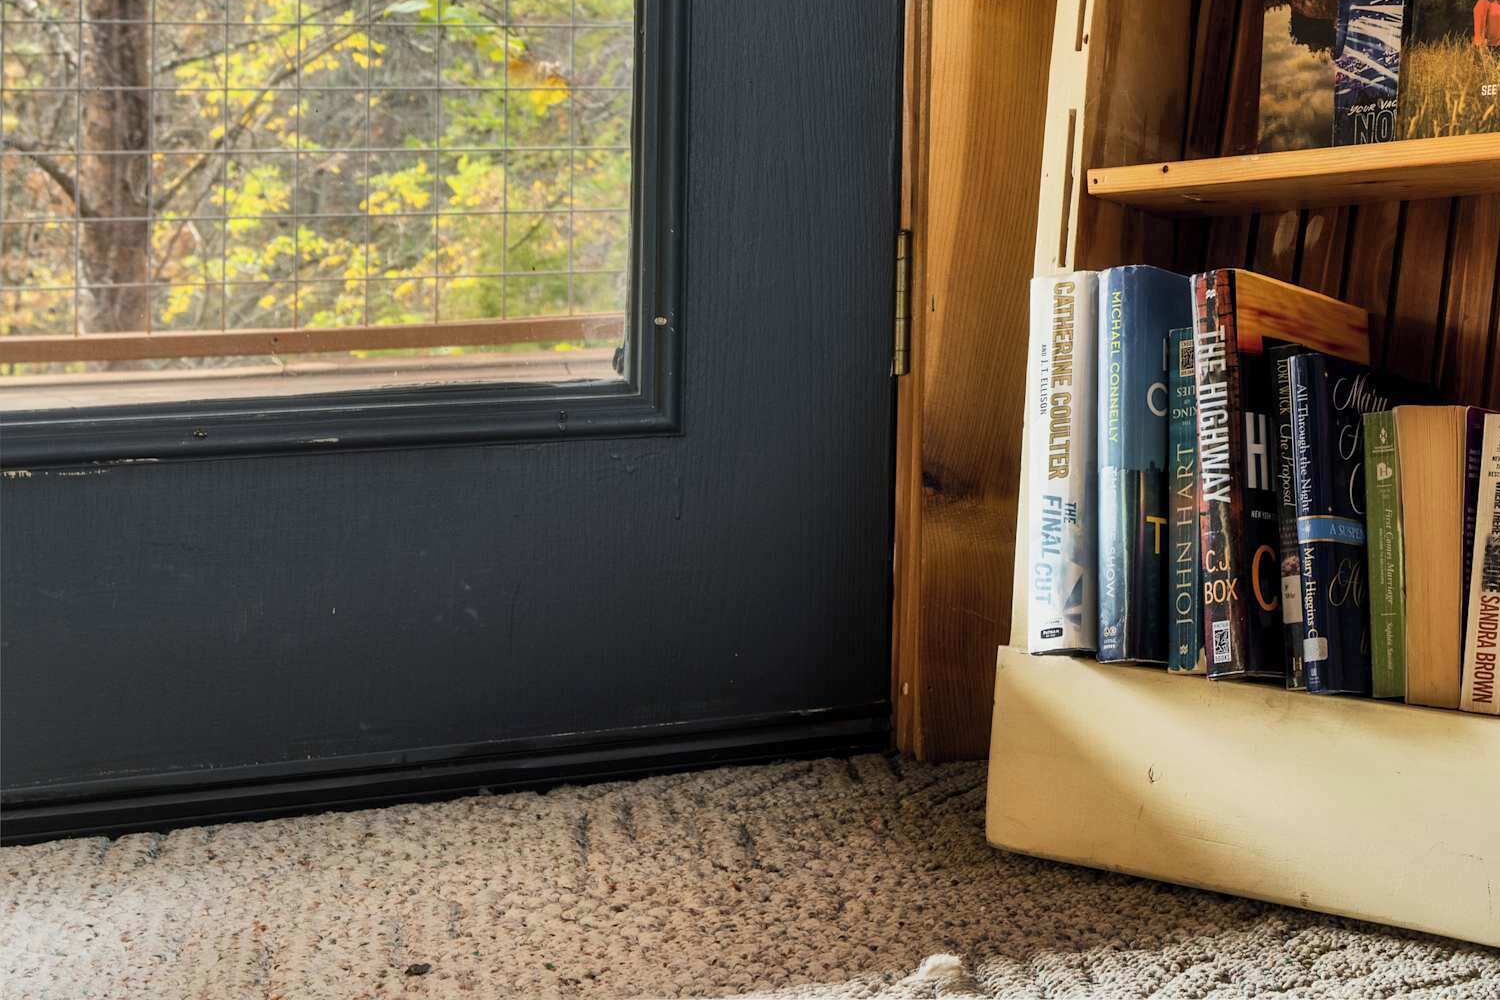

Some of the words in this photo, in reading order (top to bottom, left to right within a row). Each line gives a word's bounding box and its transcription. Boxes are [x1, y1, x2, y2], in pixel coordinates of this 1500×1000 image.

[1347, 103, 1375, 116] YOUR
[1481, 85, 1497, 96] SEE
[1354, 110, 1398, 144] NO
[1050, 281, 1075, 389] CATHERINE
[1109, 290, 1122, 355] MICHAEL
[1198, 325, 1228, 384] THE
[1277, 359, 1289, 382] LORI
[1039, 378, 1049, 415] ELLISON
[1108, 362, 1120, 442] CONNELLY
[1176, 385, 1196, 397] LIES
[1279, 385, 1291, 414] WICK
[1296, 384, 1308, 401] All
[1048, 392, 1072, 481] COULTER
[1199, 381, 1231, 504] HIGHWAY
[1297, 407, 1310, 455] Through
[1176, 443, 1194, 526] HART
[1278, 449, 1296, 507] Proposal
[1299, 456, 1310, 476] the
[1064, 502, 1077, 524] THE
[1299, 477, 1313, 513] Night
[1042, 495, 1062, 559] FINAL
[1385, 508, 1393, 529] First
[1205, 549, 1231, 573] C.J.
[1303, 547, 1315, 577] Mary
[1385, 530, 1394, 560] Comes
[1035, 562, 1053, 604] CUT
[1176, 541, 1194, 625] JOHN
[1204, 576, 1239, 605] BOX
[1385, 562, 1395, 605] Marriage
[1305, 581, 1317, 626] Higgins
[1477, 595, 1500, 650] SANDRA
[1472, 655, 1496, 704] BROWN
